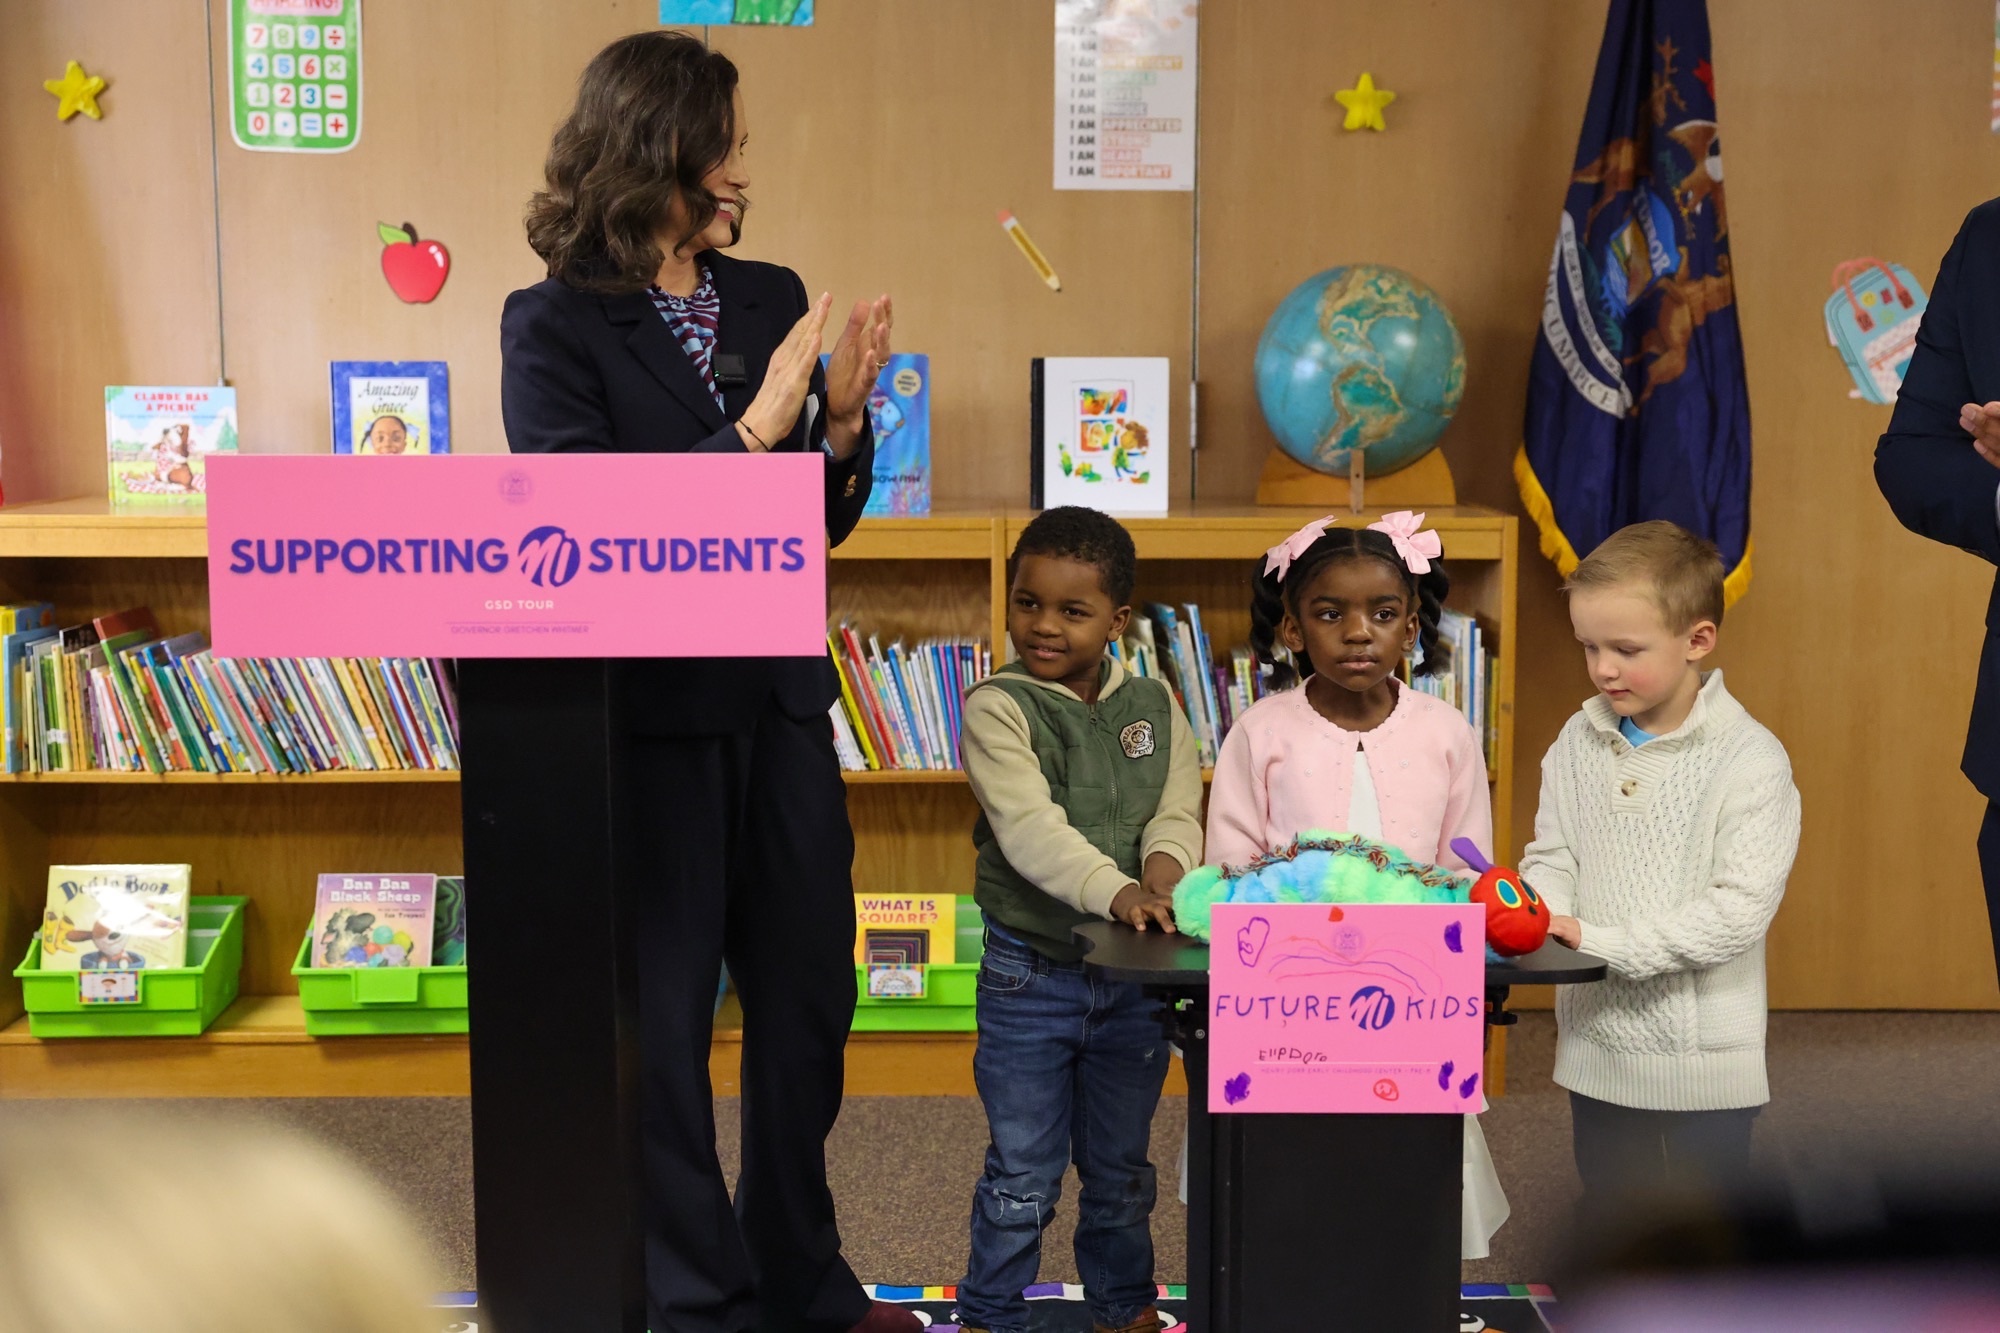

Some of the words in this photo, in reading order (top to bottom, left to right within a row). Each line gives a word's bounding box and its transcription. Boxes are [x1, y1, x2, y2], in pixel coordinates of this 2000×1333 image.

[253, 28, 263, 43] 7
[304, 29, 316, 44] 9
[252, 58, 263, 74] 4
[278, 58, 290, 74] 5
[304, 59, 316, 75] 6
[1078, 73, 1095, 82] AM
[279, 88, 291, 103] 2
[305, 88, 316, 104] 3
[1078, 105, 1095, 114] AM
[1070, 121, 1074, 130] I
[1078, 120, 1095, 130] AM
[1070, 136, 1073, 145] I
[1077, 136, 1095, 145] AM
[1070, 151, 1073, 160] I
[1077, 151, 1095, 160] AM
[1070, 167, 1073, 175] I
[1077, 166, 1095, 175] AM
[358, 380, 419, 400] Amazing
[134, 392, 181, 401] CLAUDE
[186, 393, 209, 401] HAS
[372, 398, 408, 415] Grace
[230, 538, 508, 574] SUPPORTING
[588, 536, 806, 572] STUDENTS
[485, 600, 512, 610] GSD
[517, 600, 554, 610] TOUR
[343, 878, 373, 891] Baa
[380, 878, 410, 890] Baa
[330, 891, 371, 903] Black
[377, 891, 422, 904] Sheep
[863, 900, 913, 910] WHAT
[920, 900, 935, 911] IS
[858, 913, 938, 924] SQUARE?
[1216, 995, 1342, 1020] FUTURE
[1406, 996, 1479, 1021] KIDS
